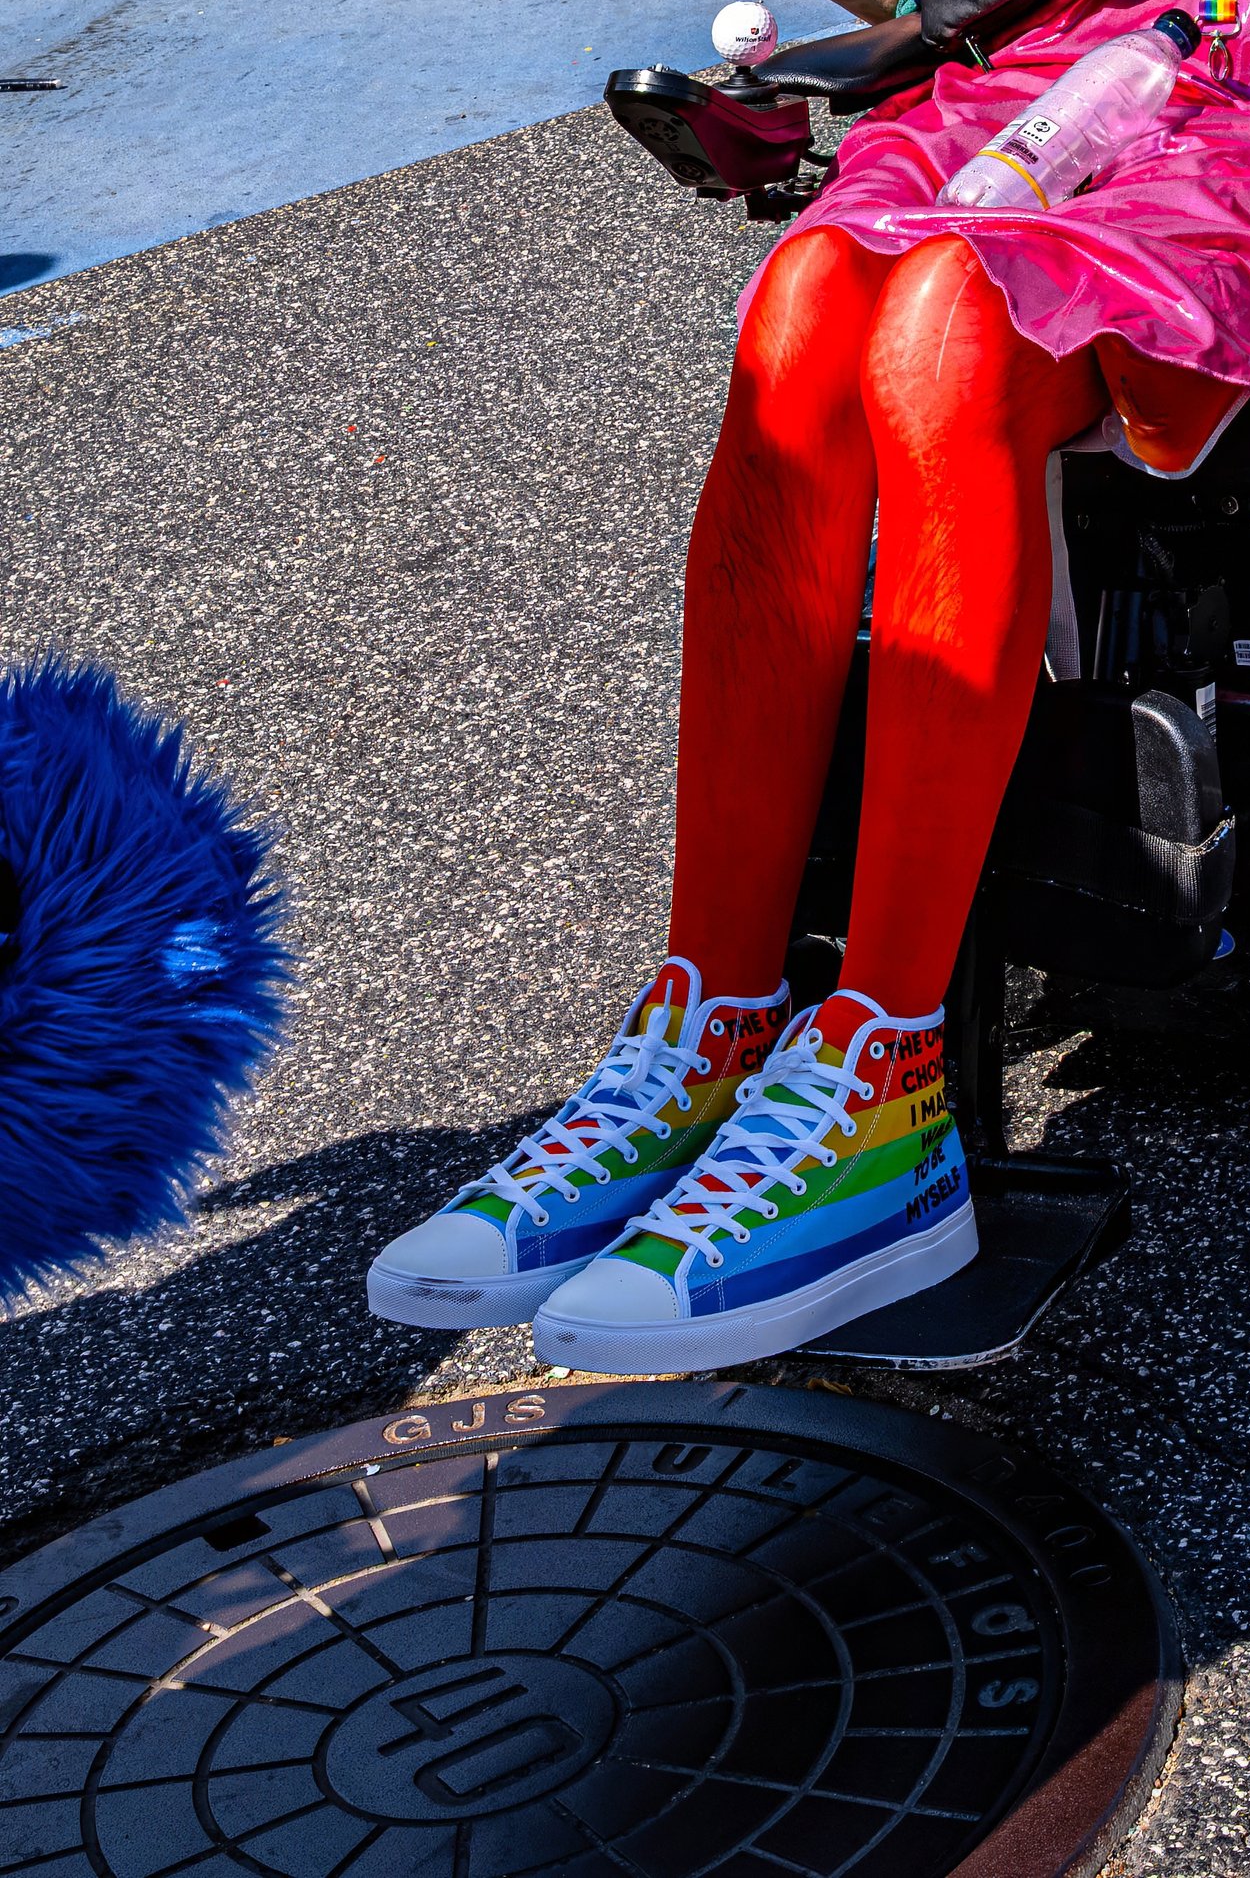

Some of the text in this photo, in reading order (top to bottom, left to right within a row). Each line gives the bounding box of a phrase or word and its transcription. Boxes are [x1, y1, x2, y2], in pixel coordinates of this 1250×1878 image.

[724, 1011, 764, 1043] THE
[885, 1032, 923, 1062] THE
[914, 1142, 946, 1186] TO BE
[905, 1165, 962, 1224] MYSELF
[383, 1394, 547, 1445] GJS
